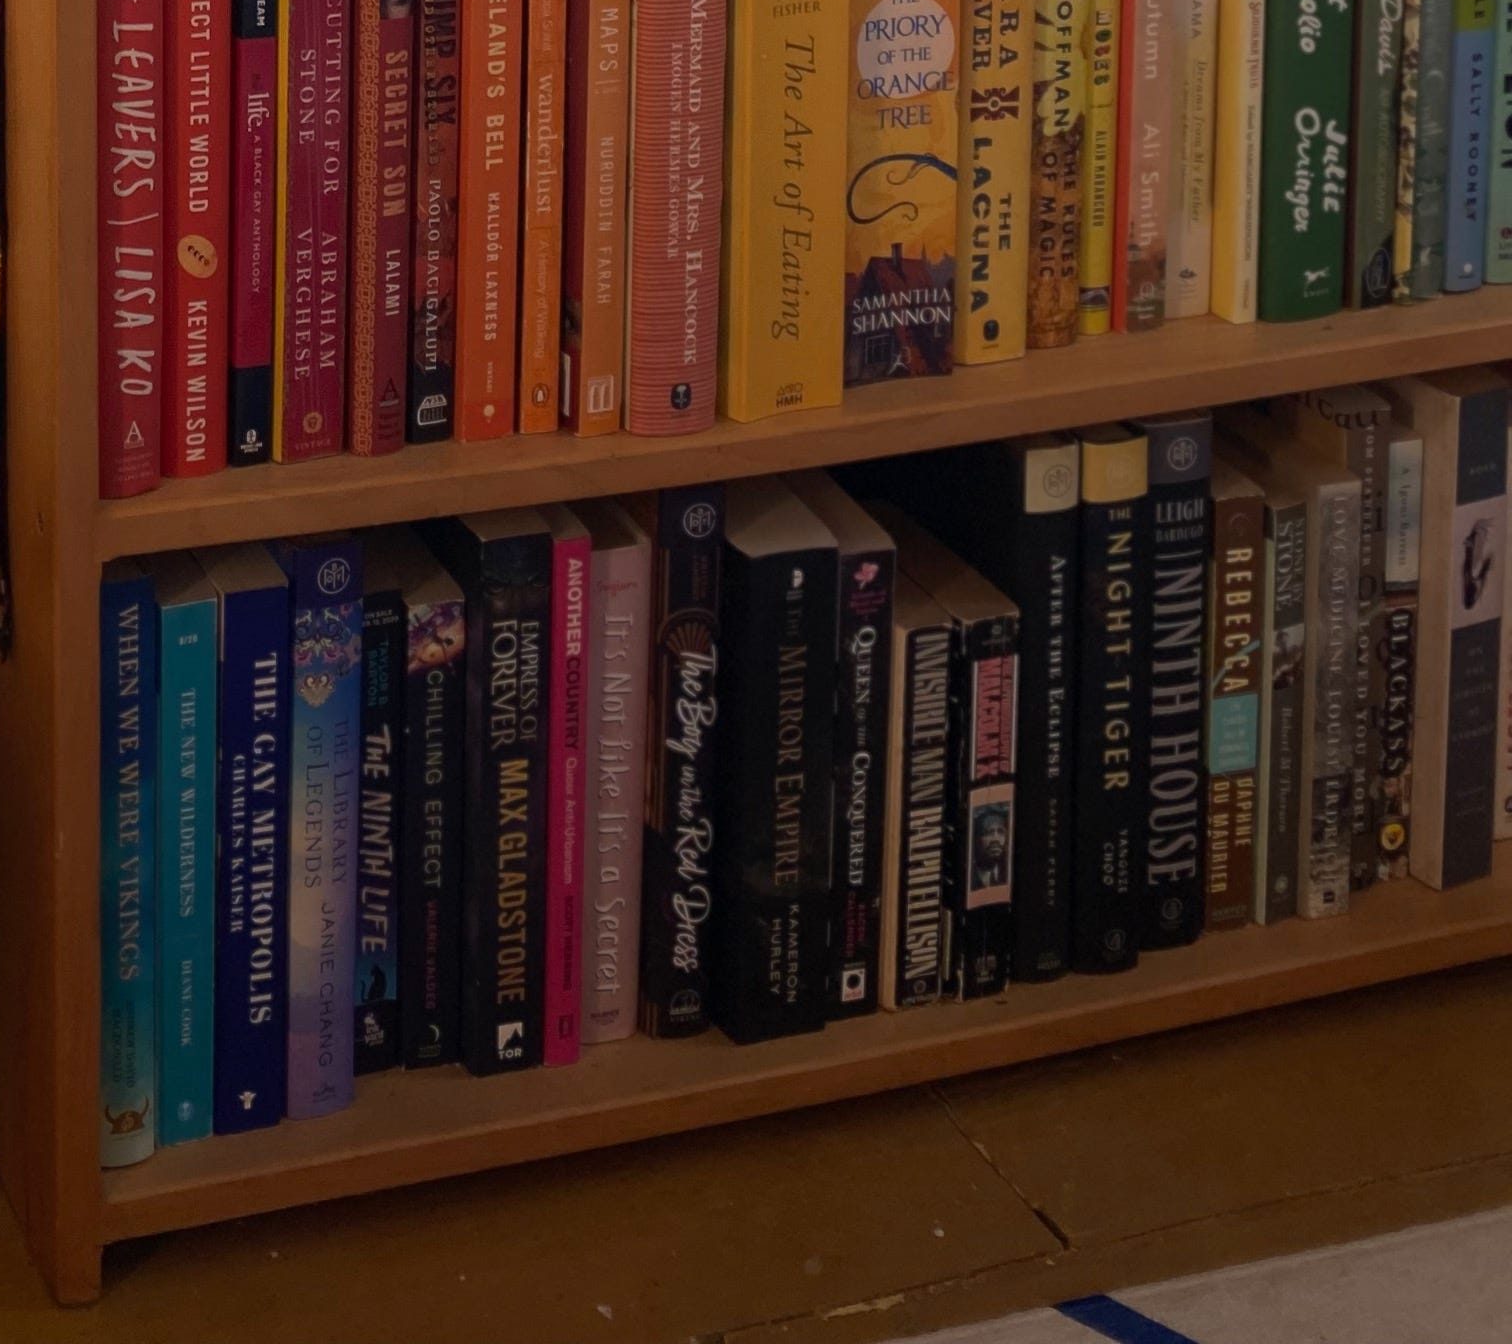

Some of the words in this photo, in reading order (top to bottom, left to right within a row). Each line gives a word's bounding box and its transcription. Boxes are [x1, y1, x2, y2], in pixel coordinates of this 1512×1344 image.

[599, 7, 620, 73] MAPS
[772, 0, 823, 20] FISHER
[863, 13, 949, 42] PRIORY
[670, 41, 684, 113] IMOGEN
[783, 33, 817, 101] The
[876, 47, 898, 64] OF
[900, 45, 932, 62] THE
[1094, 8, 1113, 87] MOSES
[110, 20, 156, 198] LEAVERS
[188, 51, 210, 127] LITTLE
[299, 49, 317, 145] STONE
[383, 48, 409, 149] SECRET
[423, 75, 457, 132] SIX
[856, 69, 956, 101] ORANGE
[875, 103, 933, 130] TREE
[1469, 52, 1484, 117] SALLY
[188, 134, 209, 213] WORLD
[253, 147, 263, 187] BLACK
[254, 134, 261, 142] A
[322, 139, 341, 195] FOR
[485, 113, 506, 172] BELL
[535, 72, 558, 217] wanderlust
[669, 119, 682, 195] HERMES
[781, 111, 815, 175] Art
[1040, 149, 1058, 183] OF
[1062, 149, 1077, 191] THE
[1142, 122, 1161, 160] Ali
[1285, 105, 1322, 233] Orringer
[1322, 118, 1348, 214] Julie
[253, 191, 262, 214] GAY
[382, 167, 408, 217] SON
[427, 179, 443, 242] PAOLO
[597, 136, 616, 233] NURUDDIN
[773, 182, 815, 223] of
[1138, 170, 1160, 247] Smith
[1466, 131, 1482, 223] ROONEY
[251, 218, 263, 295] ANTHOLOGY
[486, 191, 503, 262] HALLDÓR
[667, 198, 681, 259] GOWAR
[970, 136, 993, 314] LACUNA
[999, 191, 1012, 252] THE
[1039, 193, 1057, 279] MAGIC
[1061, 203, 1076, 279] RULES
[113, 246, 155, 329] LISA
[294, 227, 313, 382] VERGHESE
[319, 230, 337, 371] ABRAHAM
[385, 249, 402, 317] LALAMI
[423, 250, 442, 372] BACIGALUPI
[484, 271, 499, 342] LAXNESS
[597, 246, 612, 305] FARAH
[771, 225, 813, 343] Eating
[851, 286, 953, 315] SAMANTHA
[186, 300, 208, 366] KEVIN
[851, 305, 952, 336] SHANNON
[117, 348, 155, 397] KO
[775, 394, 803, 409] HMH
[185, 374, 206, 463] WILSON
[1109, 508, 1131, 523] THE
[1155, 498, 1205, 523] LEIGH
[1333, 495, 1348, 557] LOVE
[1050, 553, 1068, 627] AFTER
[1105, 530, 1133, 656] NIGHT
[1276, 519, 1295, 612] STONE
[118, 602, 140, 697] WHEN
[601, 611, 634, 662] It's
[1150, 564, 1204, 718] NINTH
[1224, 546, 1254, 693] REBECCA
[1328, 565, 1346, 675] MEDICINE
[253, 652, 278, 722] THE
[367, 648, 379, 708] BARTON
[489, 619, 517, 751] FOREVER
[519, 620, 540, 711] EMPRESS
[679, 643, 718, 698] The
[912, 631, 950, 743] INVISIBLE
[1049, 635, 1064, 681] THE
[1386, 613, 1410, 773] BLACKASS
[118, 704, 139, 754] WE
[180, 687, 196, 729] THE
[425, 669, 444, 785] CHILLING
[518, 715, 538, 743] OF
[600, 671, 633, 725] Not
[664, 697, 717, 761] Boy
[776, 645, 807, 765] MIRROR
[975, 658, 1002, 753] MALCOLM
[1047, 687, 1067, 780] ECLIPSE
[1102, 673, 1131, 791] TIGER
[180, 735, 196, 780] NEW
[252, 731, 277, 794] GAY
[306, 723, 323, 758] OF
[333, 718, 349, 760] THE
[364, 723, 393, 780] THE
[595, 736, 633, 800] Like
[909, 745, 947, 803] MAN
[974, 754, 999, 781] X
[118, 760, 139, 847] WERE
[232, 753, 246, 848] CHARLES
[498, 758, 529, 825] MAX
[679, 786, 702, 820] the
[680, 765, 697, 788] in
[1147, 727, 1201, 886] HOUSE
[1213, 780, 1231, 804] DU
[303, 760, 330, 890] LEGENDS
[330, 768, 354, 886] LIBRARY
[359, 788, 394, 878] NINTH
[423, 799, 441, 888] EFFECT
[595, 811, 629, 853] It's
[773, 773, 805, 887] EMPIRE
[907, 806, 944, 886] RALPH
[1235, 777, 1255, 848] DAPHNE
[178, 786, 196, 919] WILDERNESS
[596, 865, 621, 886] a
[674, 818, 713, 882] Red
[1101, 841, 1116, 886] CHOO
[1210, 813, 1230, 896] MAURIER
[117, 855, 140, 982] VIKINGS
[229, 857, 244, 934] KAISER
[248, 809, 276, 1025] METROPOLIS
[361, 884, 390, 955] LIFE
[495, 831, 527, 1005] GLADSTONE
[671, 884, 711, 973] Dress
[319, 902, 337, 974] JANIE
[591, 896, 627, 996] Secret
[769, 917, 783, 995] HURLEY
[786, 903, 801, 1003] KAMERON
[904, 885, 941, 981] ELLISON
[180, 959, 193, 1004] DIANE
[179, 1008, 193, 1048] COOK
[318, 981, 335, 1069] CHANG
[498, 1049, 522, 1059] TOR
